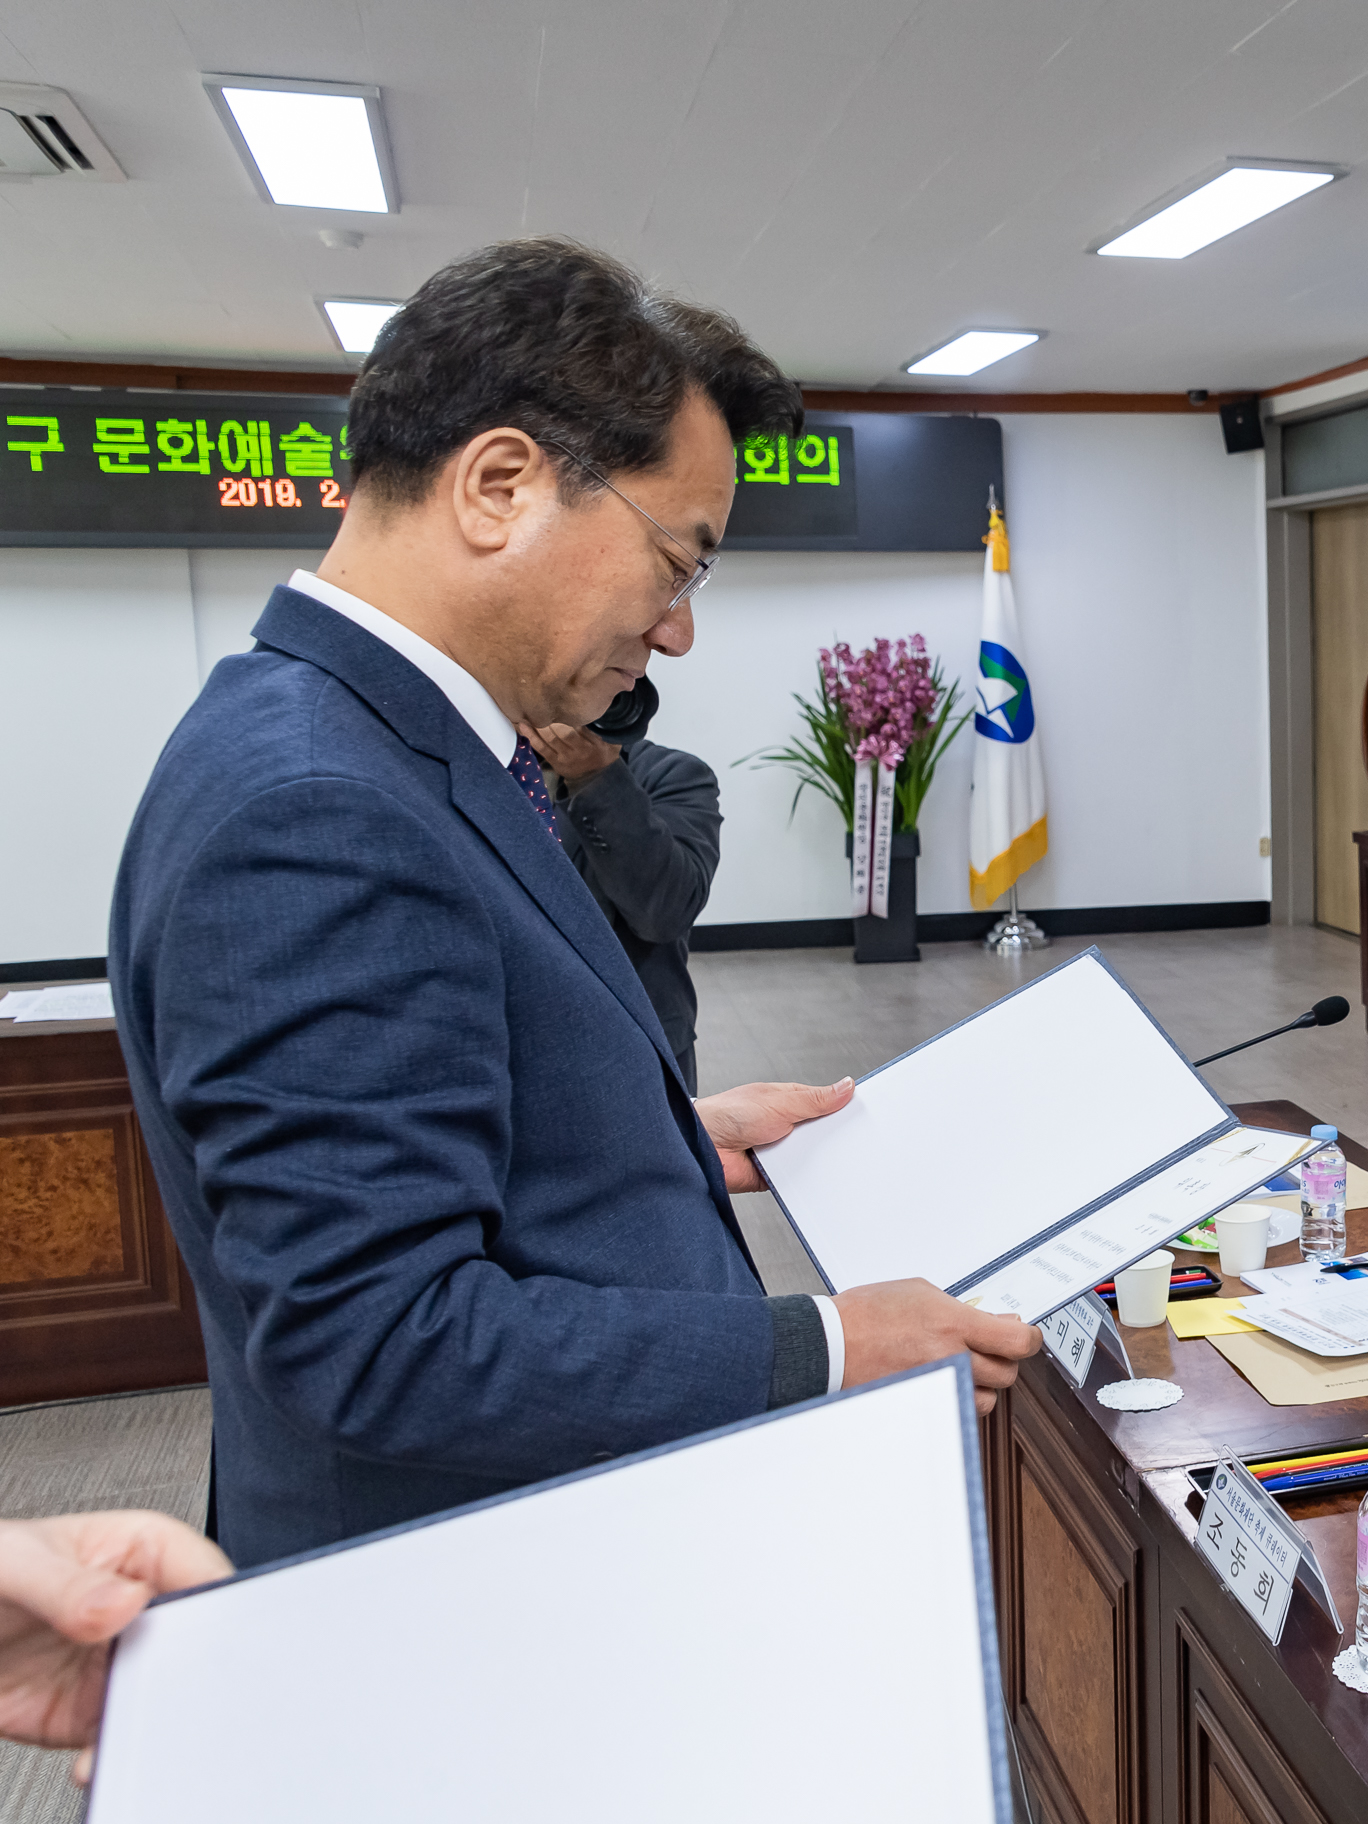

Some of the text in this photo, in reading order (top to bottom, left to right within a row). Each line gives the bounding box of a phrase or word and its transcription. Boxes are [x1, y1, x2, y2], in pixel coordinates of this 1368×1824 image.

[7, 416, 65, 471] 구
[93, 418, 352, 477] 문화예술
[218, 477, 302, 507] 2019.
[1226, 1487, 1288, 1568] 서울문화재단 축제 큐레이터
